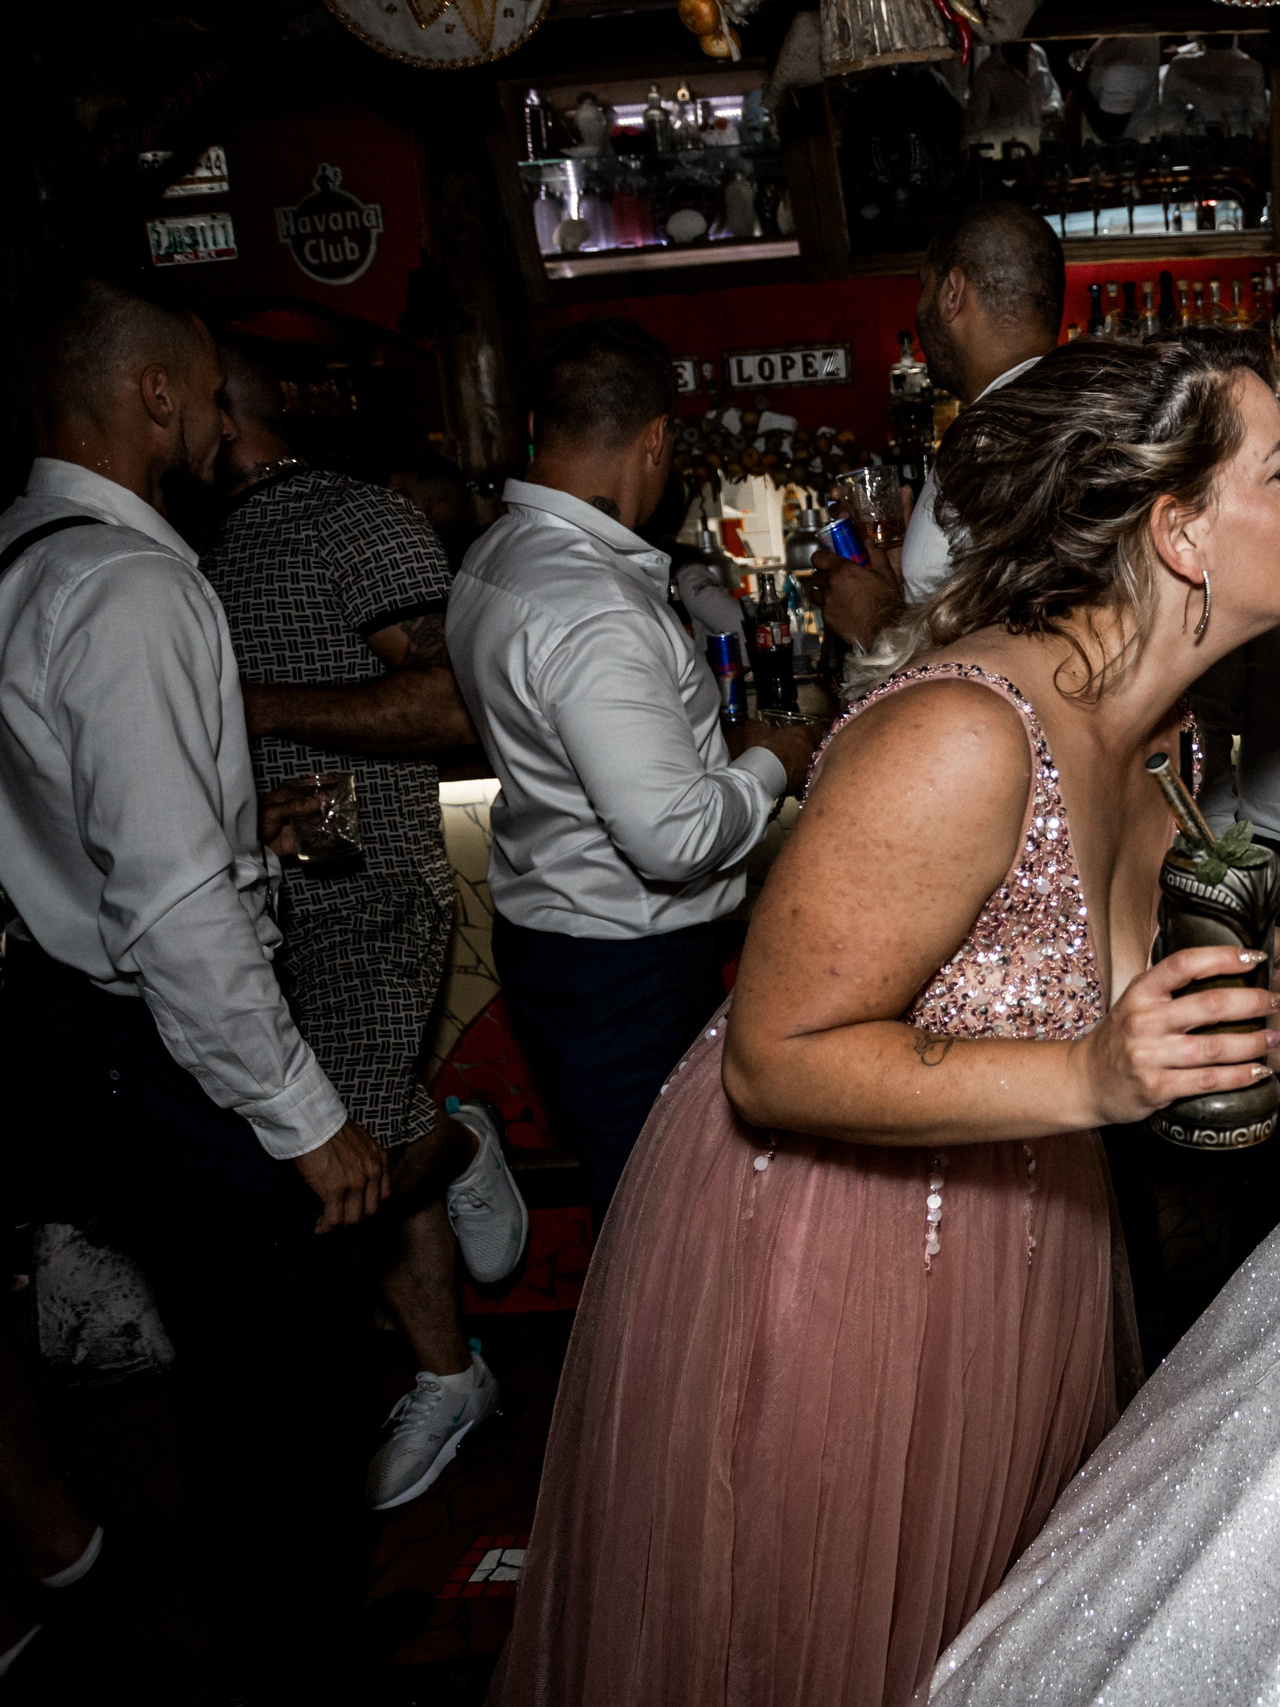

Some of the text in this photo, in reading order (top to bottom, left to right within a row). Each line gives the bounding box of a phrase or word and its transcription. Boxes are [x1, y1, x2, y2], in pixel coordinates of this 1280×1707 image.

[280, 207, 379, 237] Havana
[303, 235, 361, 266] Club
[735, 352, 841, 383] LOPEZ
